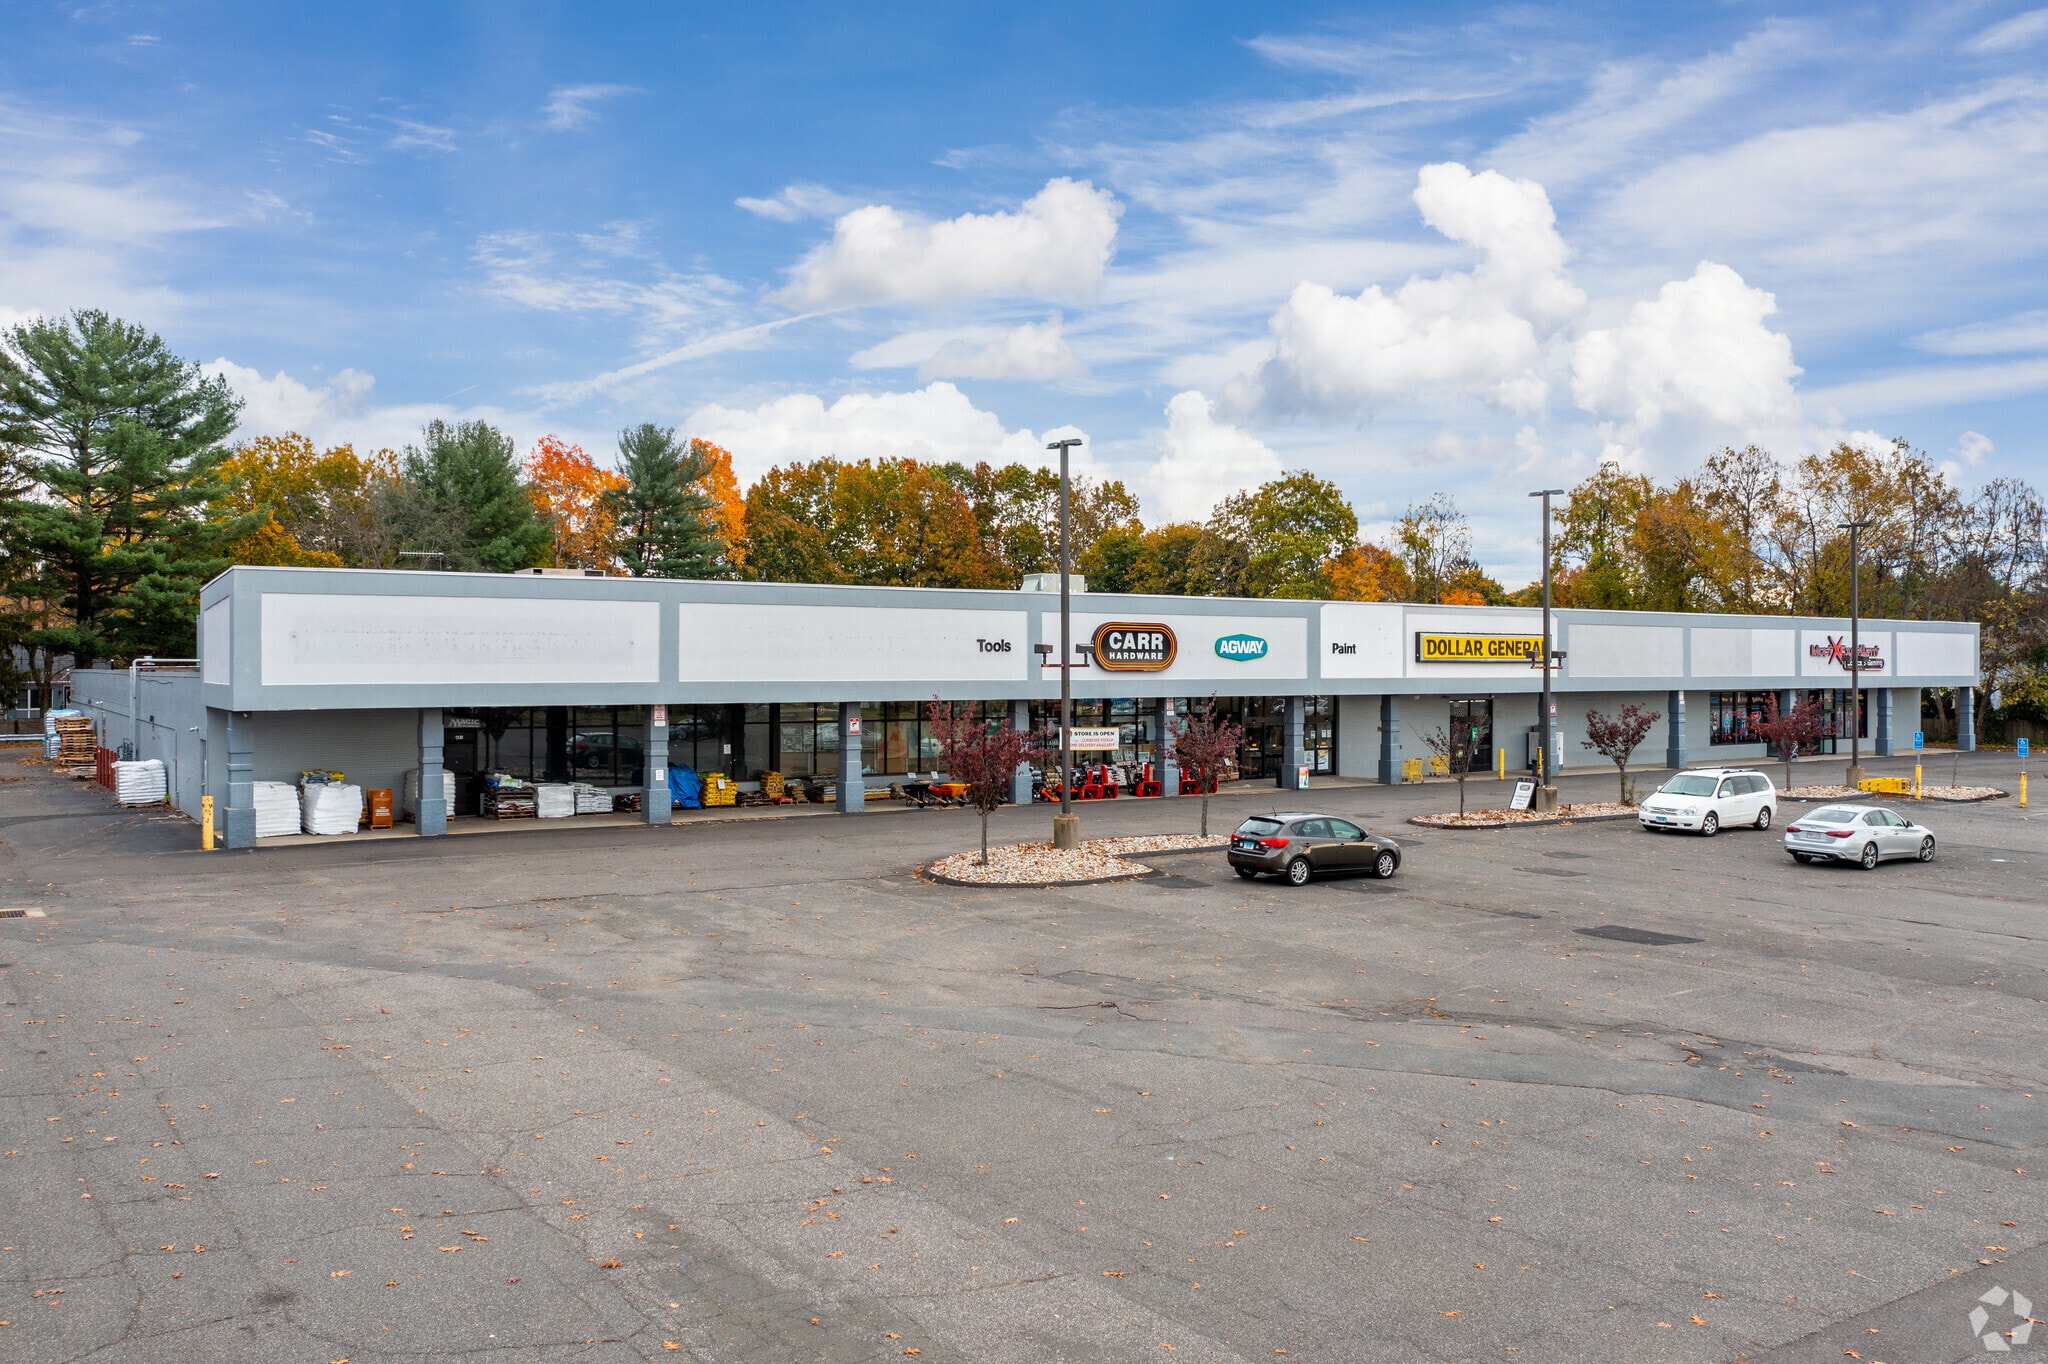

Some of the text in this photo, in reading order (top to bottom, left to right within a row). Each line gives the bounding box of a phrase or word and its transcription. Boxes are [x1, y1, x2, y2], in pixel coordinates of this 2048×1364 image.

[976, 639, 1012, 653] Tools
[1109, 632, 1163, 650] CARR
[1219, 640, 1265, 654] AGWAY
[1426, 639, 1545, 657] DOLLAR GENERA
[1332, 642, 1357, 655] Paint
[1109, 652, 1163, 660] HARDWARE
